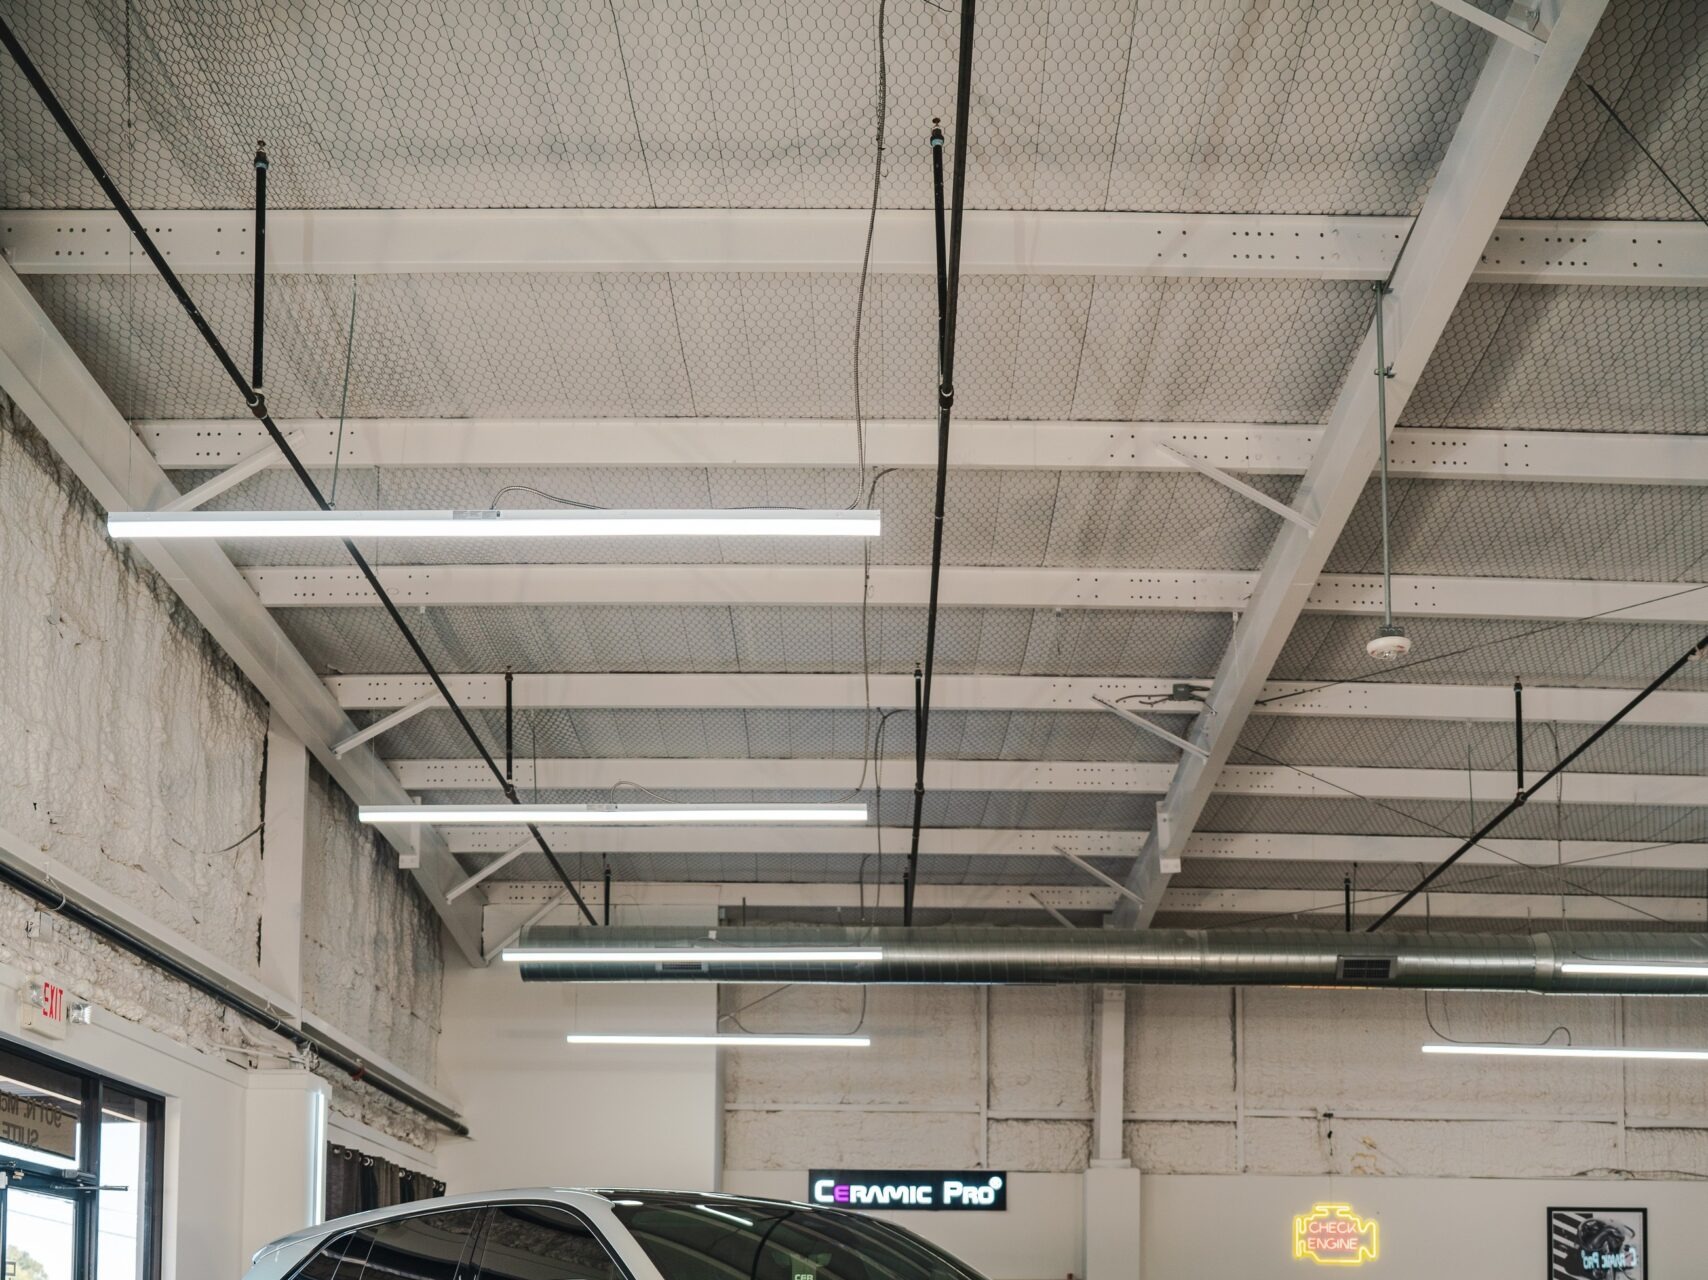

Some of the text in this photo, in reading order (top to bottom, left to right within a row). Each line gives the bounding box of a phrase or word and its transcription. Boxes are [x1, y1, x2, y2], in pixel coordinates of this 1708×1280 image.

[43, 982, 63, 1022] EXIT
[1308, 1221, 1358, 1234] CHECK
[1307, 1237, 1358, 1250] ENGINE
